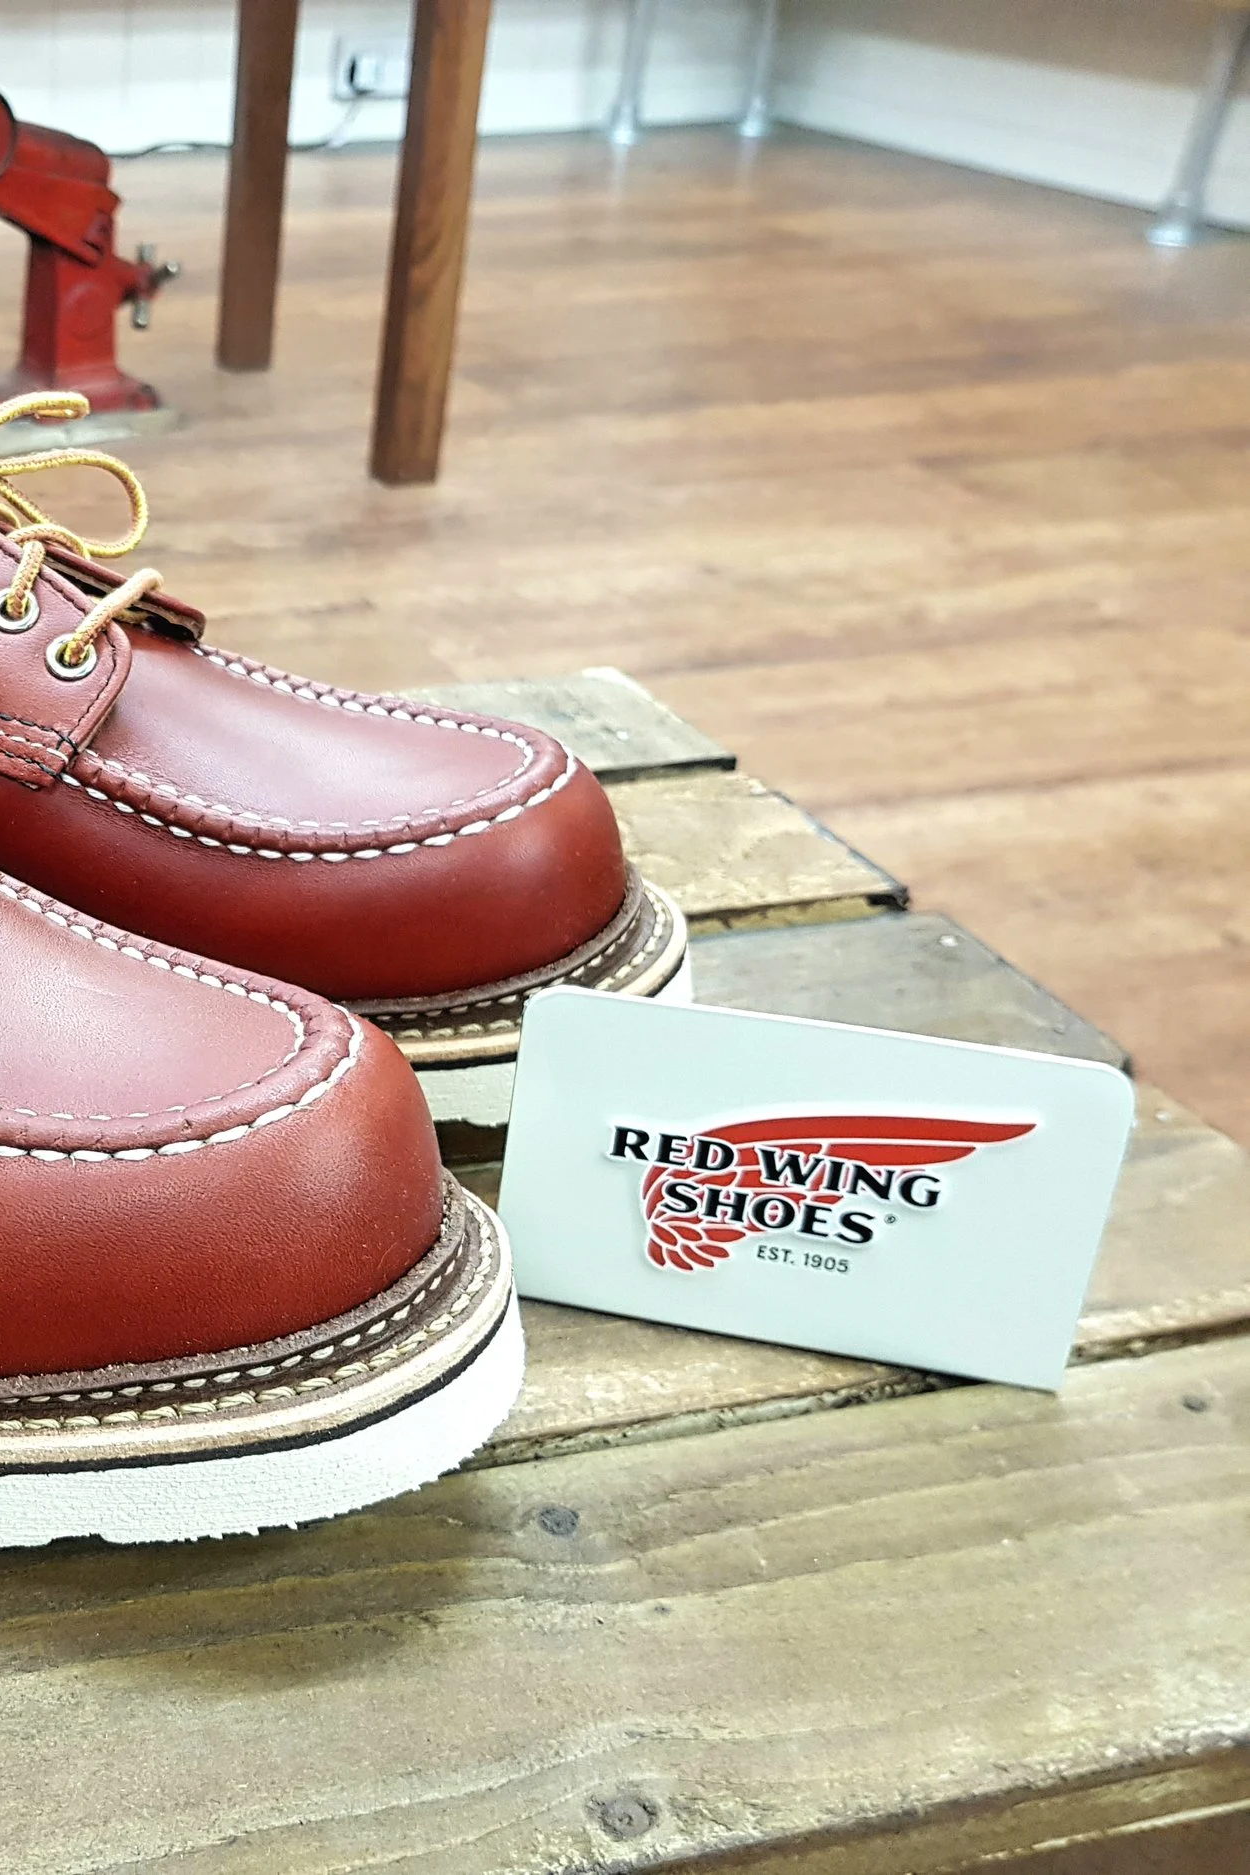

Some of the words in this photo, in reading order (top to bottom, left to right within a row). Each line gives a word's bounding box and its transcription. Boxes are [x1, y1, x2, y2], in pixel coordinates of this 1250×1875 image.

[610, 1126, 735, 1171] RED
[760, 1148, 941, 1208] WING
[661, 1183, 875, 1244] SHOES
[756, 1245, 796, 1266] EST.
[803, 1252, 850, 1275] 1905
